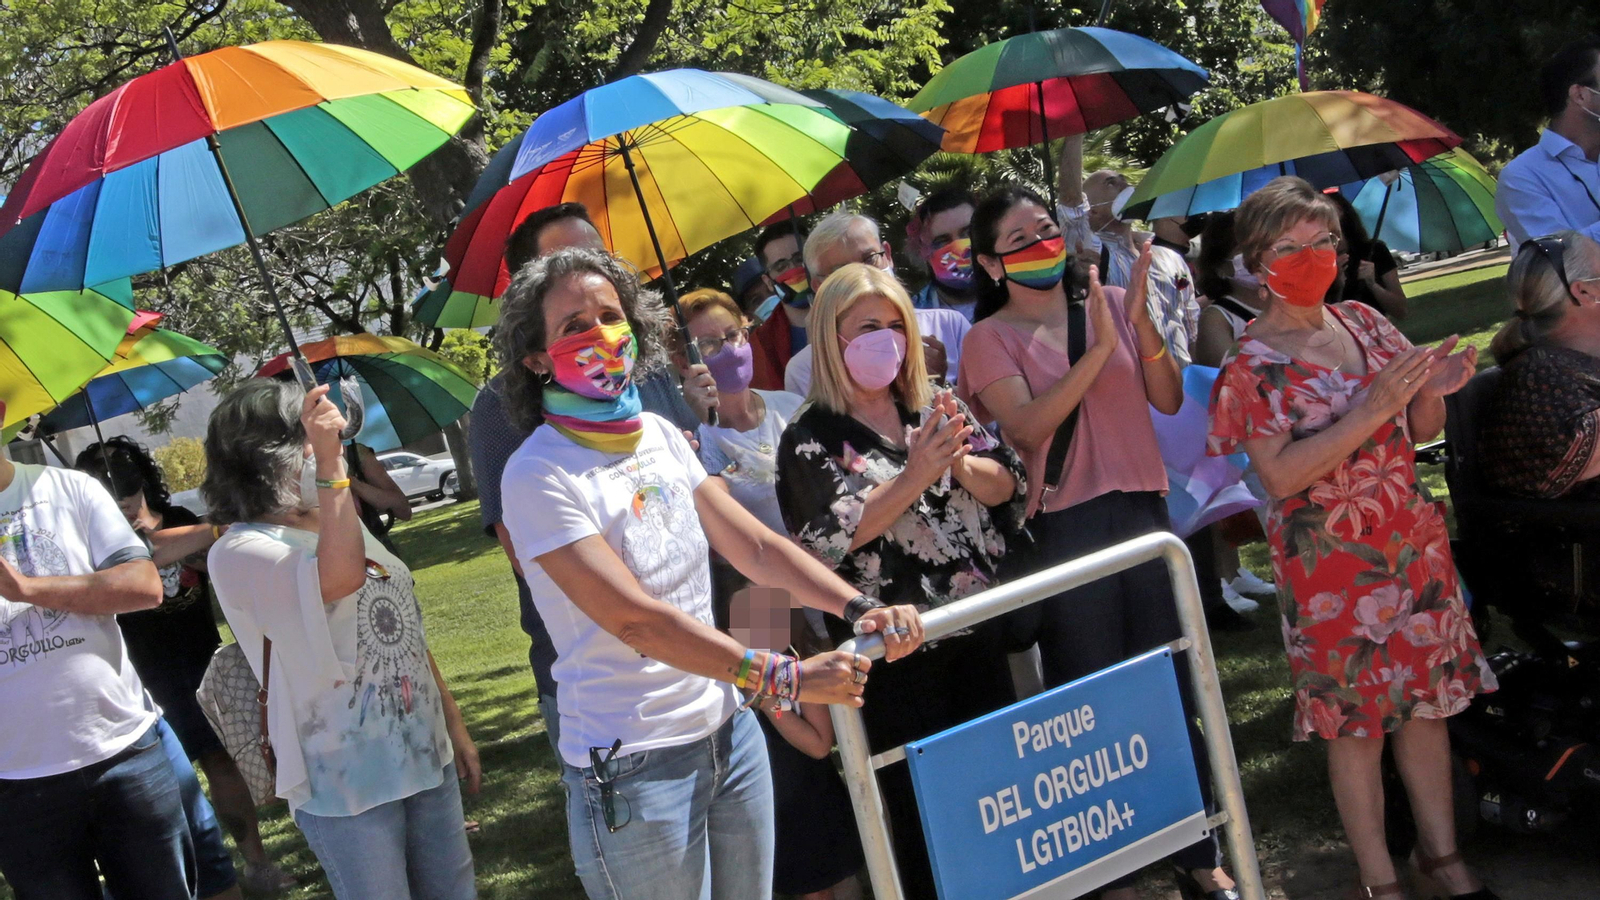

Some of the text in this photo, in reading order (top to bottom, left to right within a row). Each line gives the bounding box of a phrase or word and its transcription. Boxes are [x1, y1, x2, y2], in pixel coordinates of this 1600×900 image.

[0, 635, 64, 665] ORGULLO
[1012, 704, 1096, 759] Parque
[978, 733, 1149, 835] DEL ORGULLO
[1015, 798, 1136, 874] LGTBIQA+
